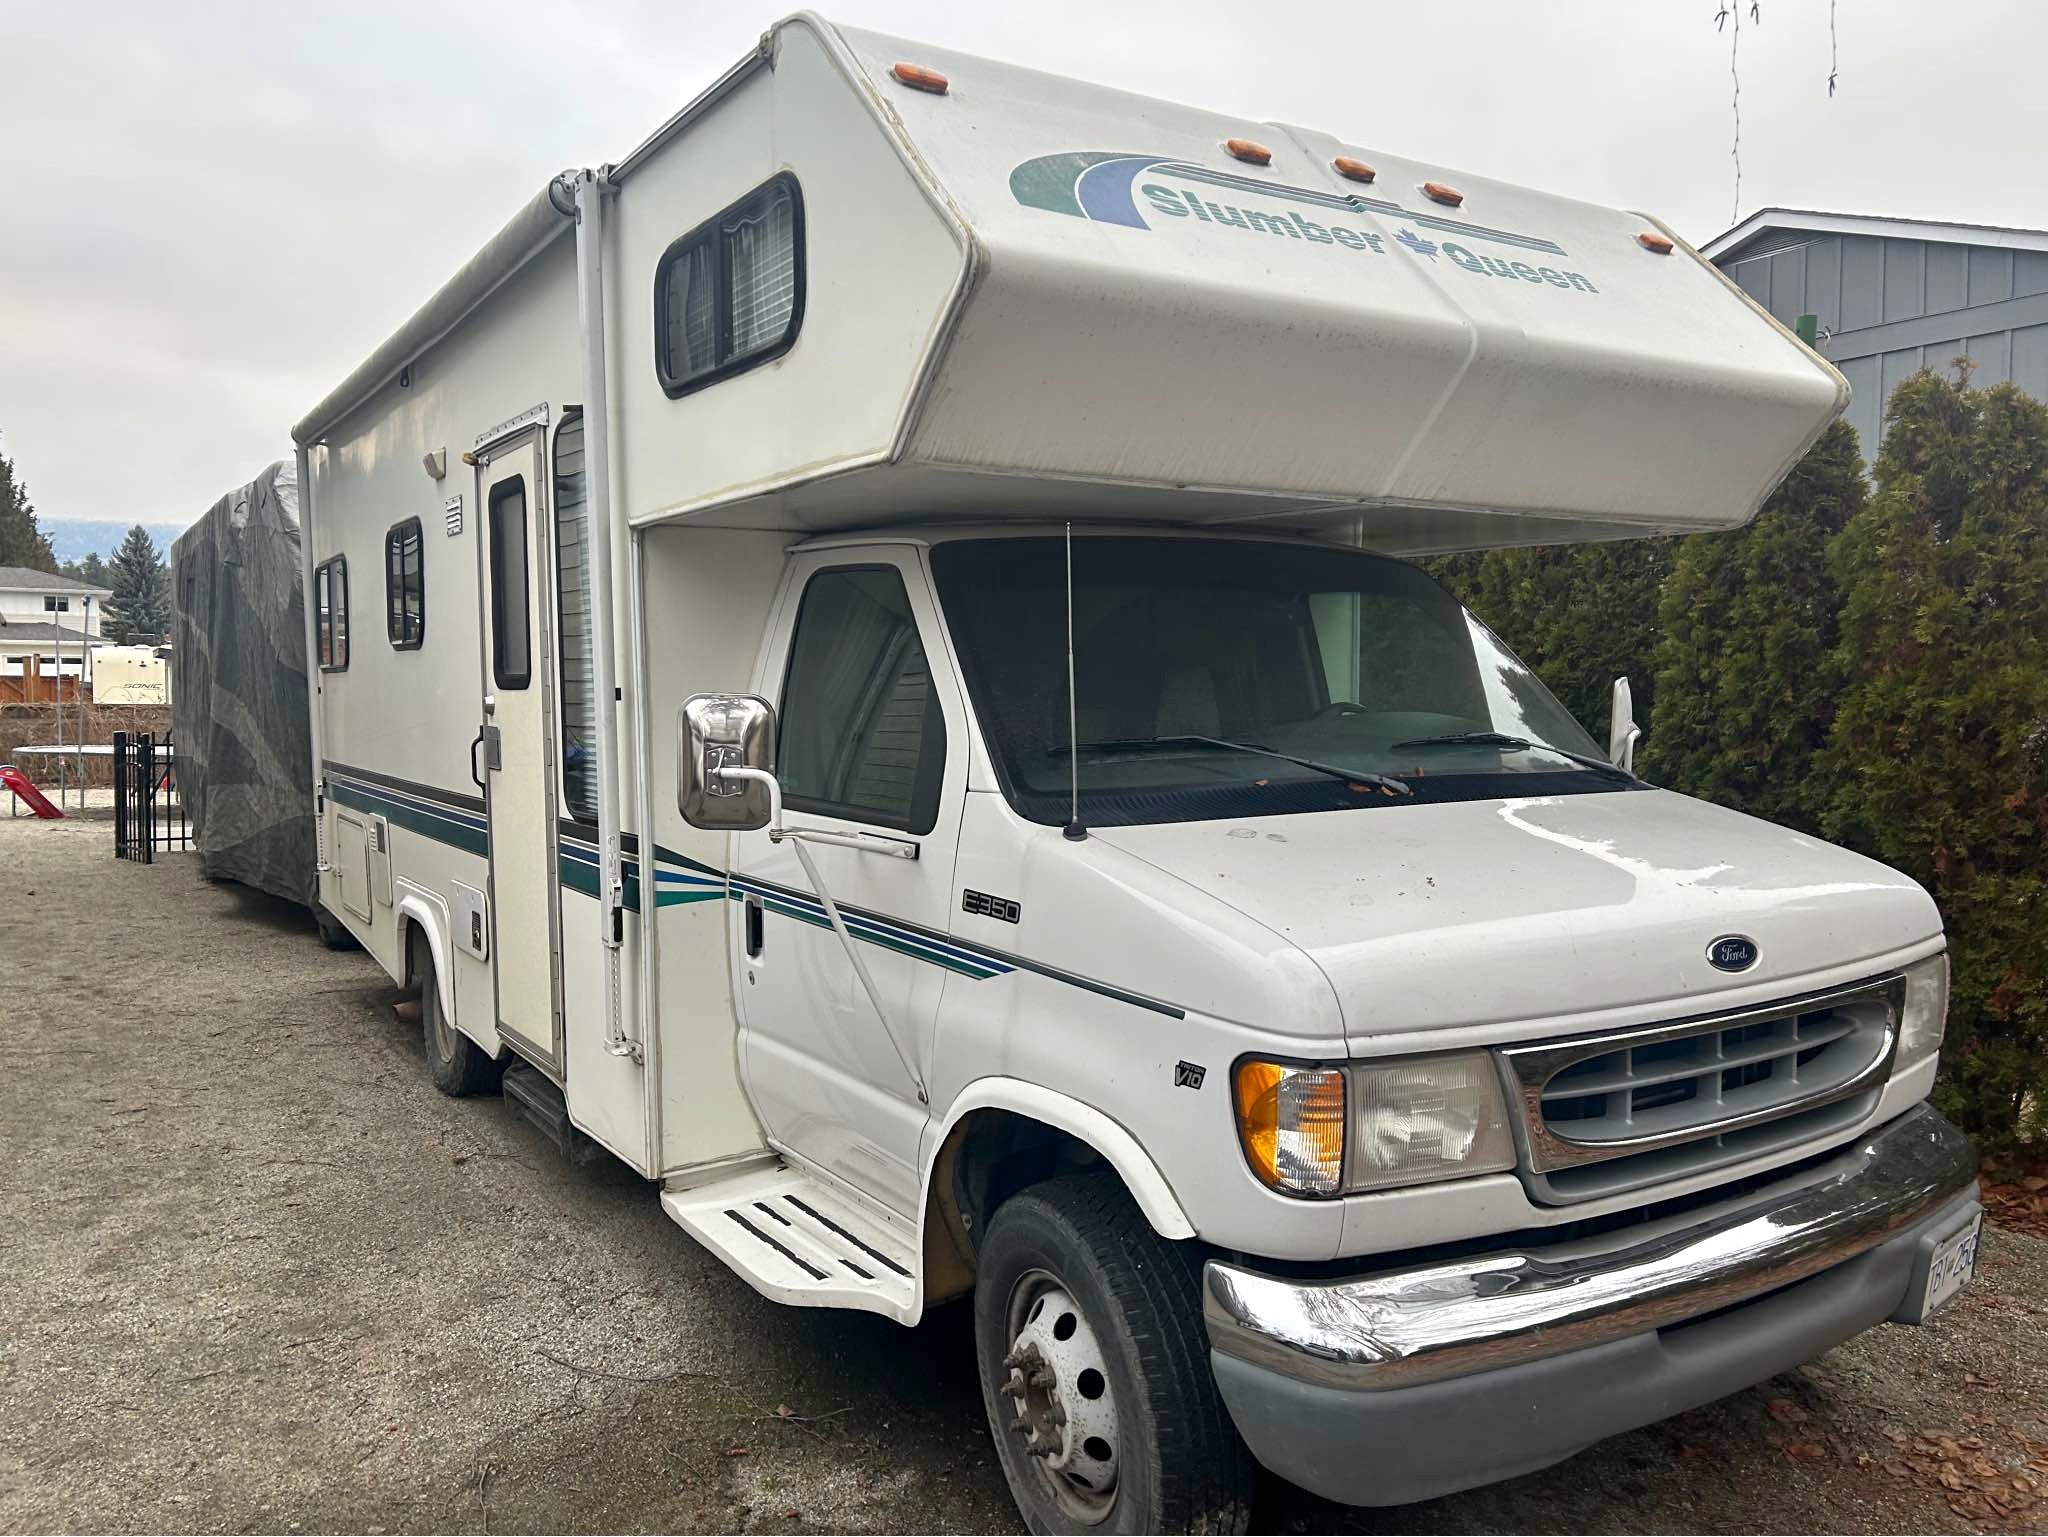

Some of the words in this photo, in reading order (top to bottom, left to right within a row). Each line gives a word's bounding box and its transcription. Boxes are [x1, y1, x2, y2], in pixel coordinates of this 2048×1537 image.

[1141, 183, 1385, 254] Slumber
[1441, 241, 1600, 294] Queen
[1721, 943, 1748, 962] Ford
[1175, 1067, 1202, 1088] V10
